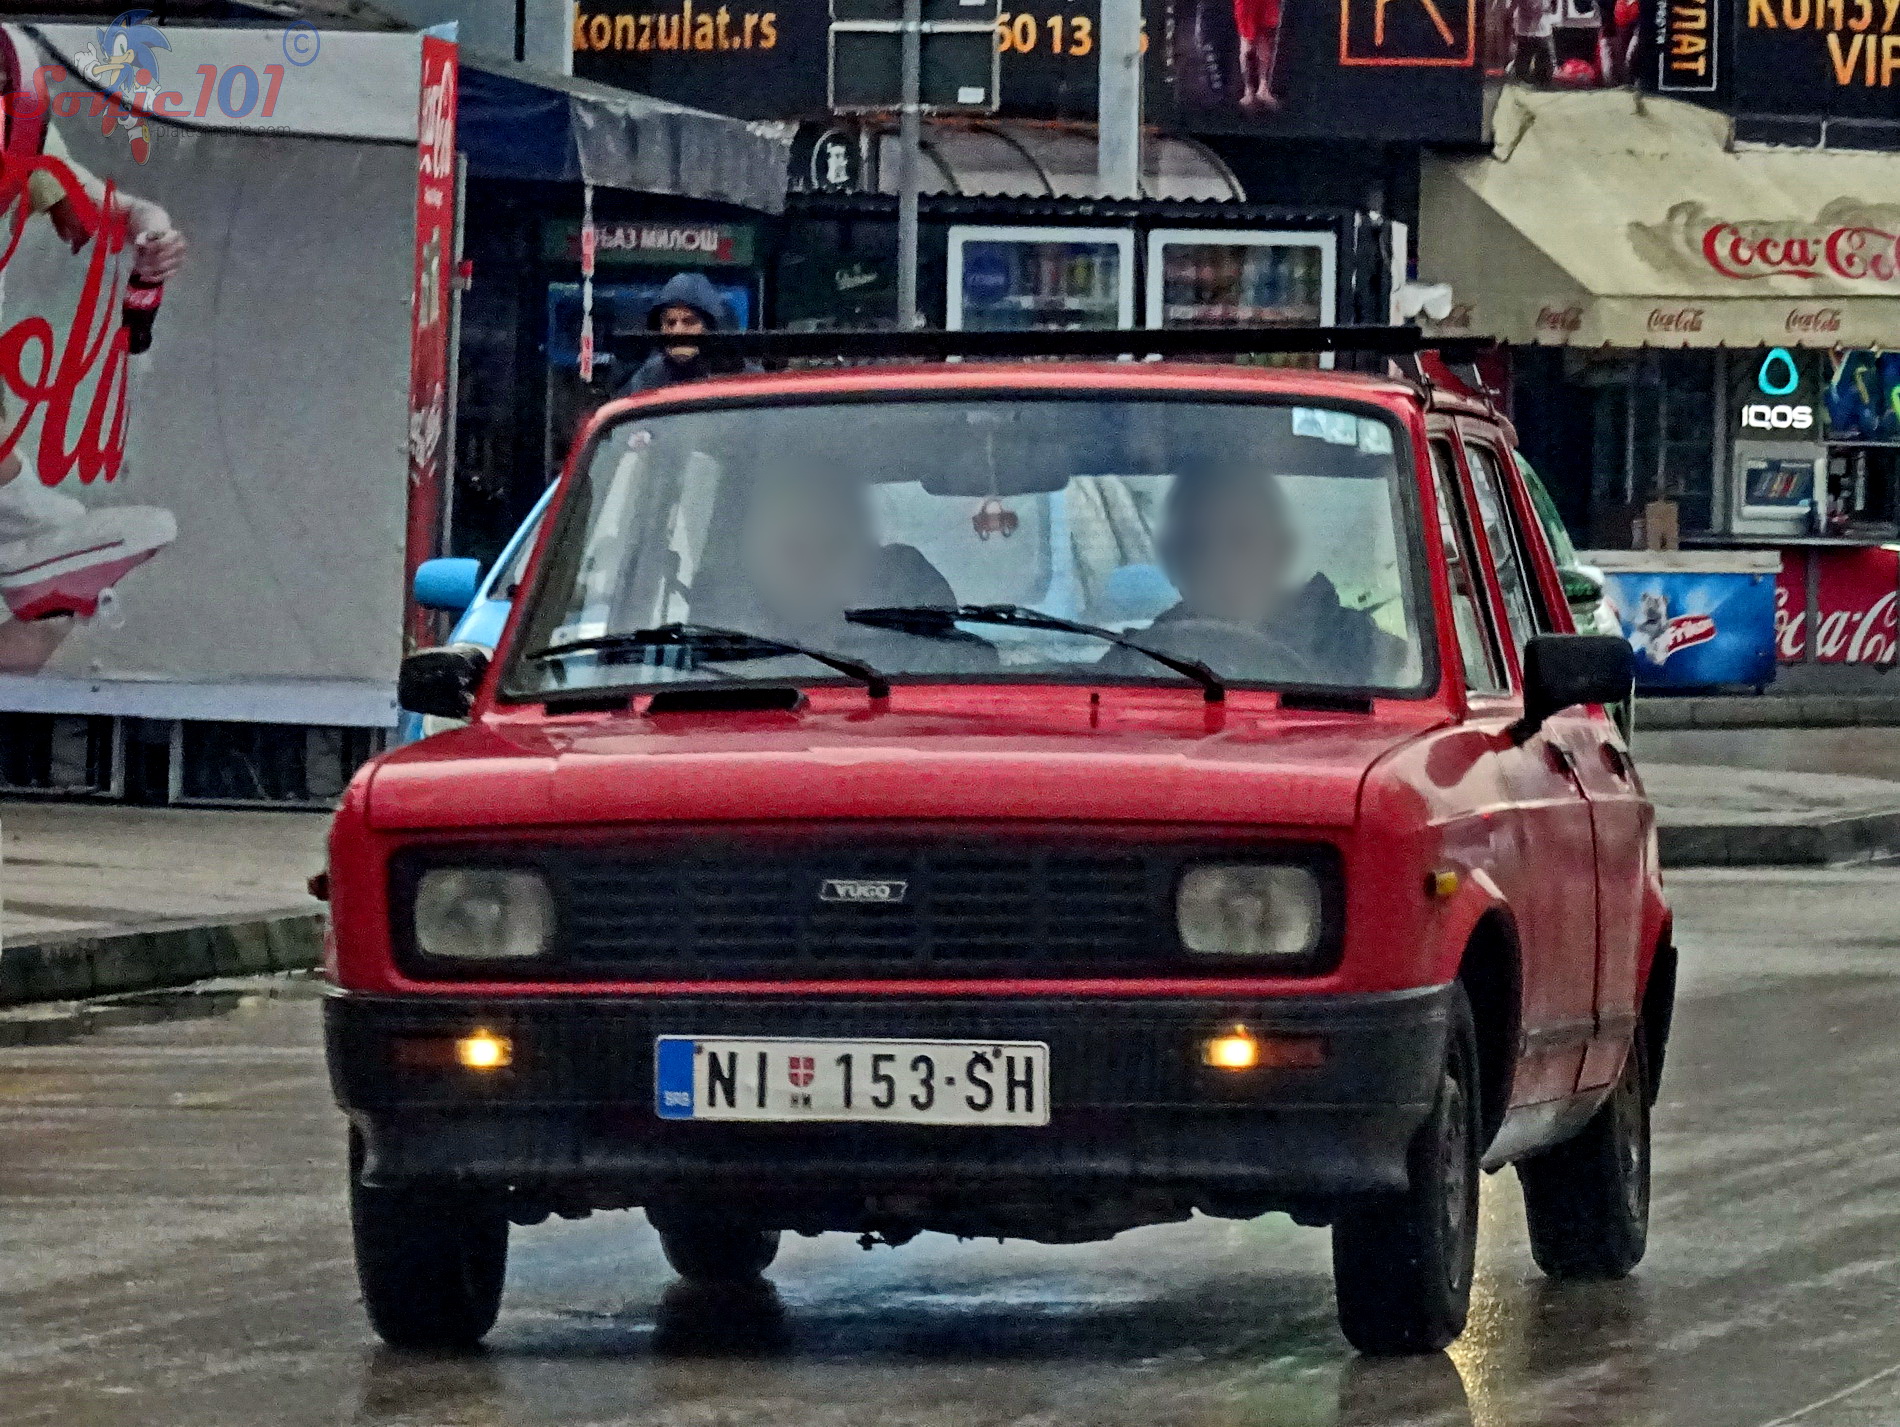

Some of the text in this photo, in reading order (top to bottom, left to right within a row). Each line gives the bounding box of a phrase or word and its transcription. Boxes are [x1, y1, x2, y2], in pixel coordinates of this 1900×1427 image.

[574, 0, 777, 50] konzulat.rs
[1047, 15, 1093, 56] 13
[1669, 0, 1708, 76] ЛАТ
[1702, 222, 1900, 281] Coca-Co
[1741, 404, 1813, 431] IQOS
[708, 1051, 768, 1109] NI
